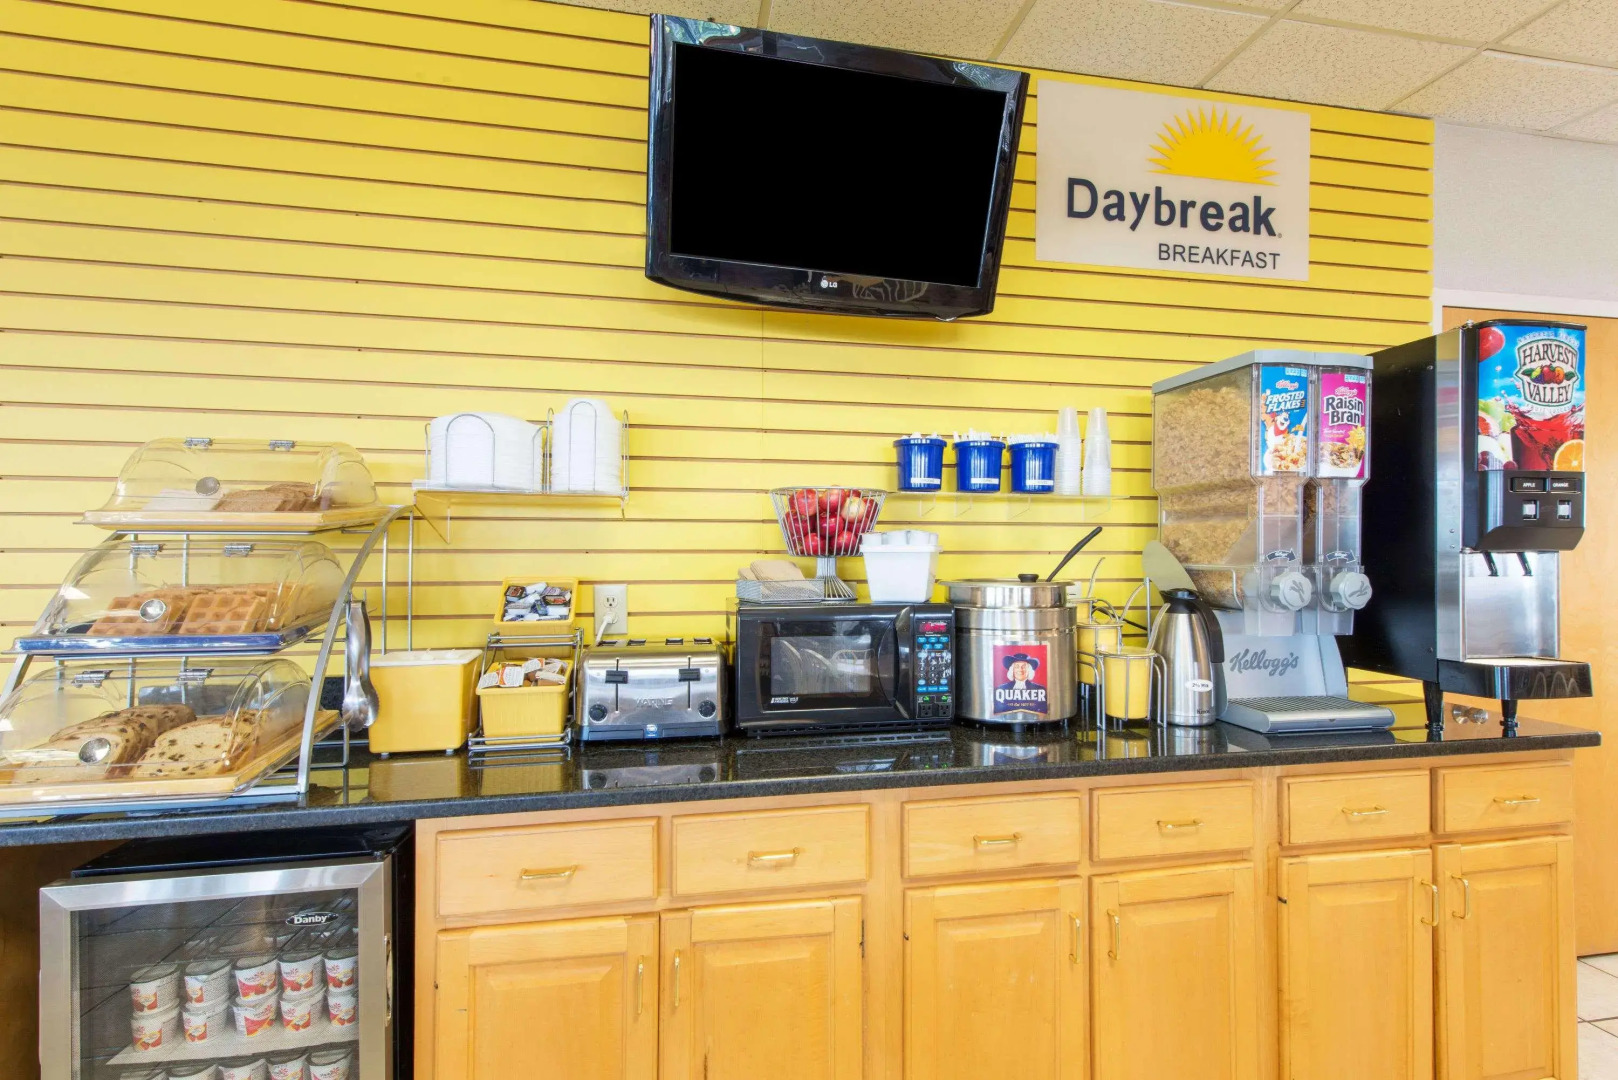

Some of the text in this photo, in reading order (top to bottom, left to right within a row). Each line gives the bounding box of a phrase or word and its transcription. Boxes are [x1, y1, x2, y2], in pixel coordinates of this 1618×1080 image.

[1068, 177, 1277, 237] Daybreak
[1158, 243, 1281, 270] BREAKFAST
[1521, 343, 1576, 369] HARVEST
[1266, 391, 1305, 405] FROSTED
[1527, 381, 1571, 404] VALLEY
[1267, 400, 1300, 412] FLAKES
[1325, 396, 1364, 413] Raisin
[1331, 411, 1361, 424] Bran
[1229, 648, 1300, 677] Kellogg's
[995, 688, 1046, 703] QUAKER
[294, 915, 328, 925] Danby
